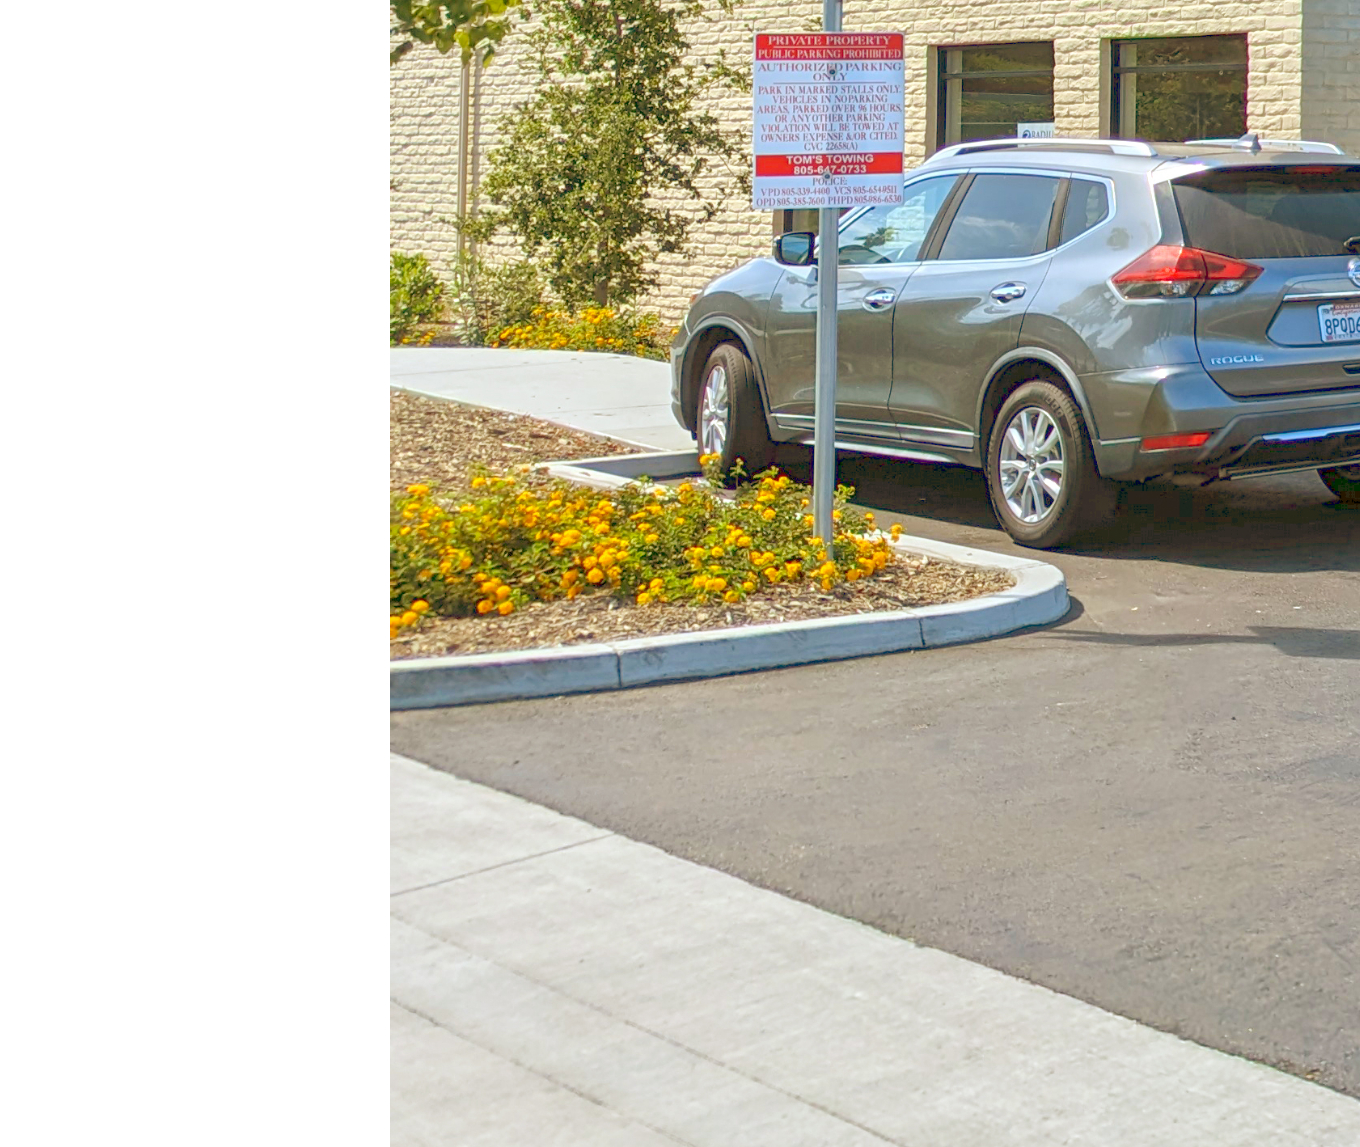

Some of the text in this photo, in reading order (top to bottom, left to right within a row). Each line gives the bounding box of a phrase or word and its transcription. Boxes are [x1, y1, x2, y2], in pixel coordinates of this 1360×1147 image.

[768, 35, 891, 46] PRIVATE PROPERTY
[758, 49, 901, 59] PUBLIC PARKING PROHIBITED
[758, 63, 901, 72] AUTHORIZED PARKING
[812, 73, 847, 81] ONLY
[758, 86, 782, 95] PARK
[785, 86, 796, 95] IN
[798, 85, 838, 94] MARKED
[841, 85, 874, 94] STALLS
[772, 95, 818, 104] VEHICLES
[821, 95, 831, 103] IN
[793, 104, 829, 113] PARKED
[832, 104, 856, 112] OVER
[858, 104, 867, 112] 96
[774, 114, 787, 123] OR
[846, 113, 886, 122] PARKING
[761, 122, 899, 132] VIOLATION WILL BE TOWED AT
[761, 133, 800, 142] OWNERS
[803, 133, 843, 141] EXPENSE
[804, 142, 823, 151] CVC
[786, 153, 874, 165] TOM'S TOWING
[793, 164, 867, 175] 805-647-0733
[1210, 354, 1264, 365] ROGUE
